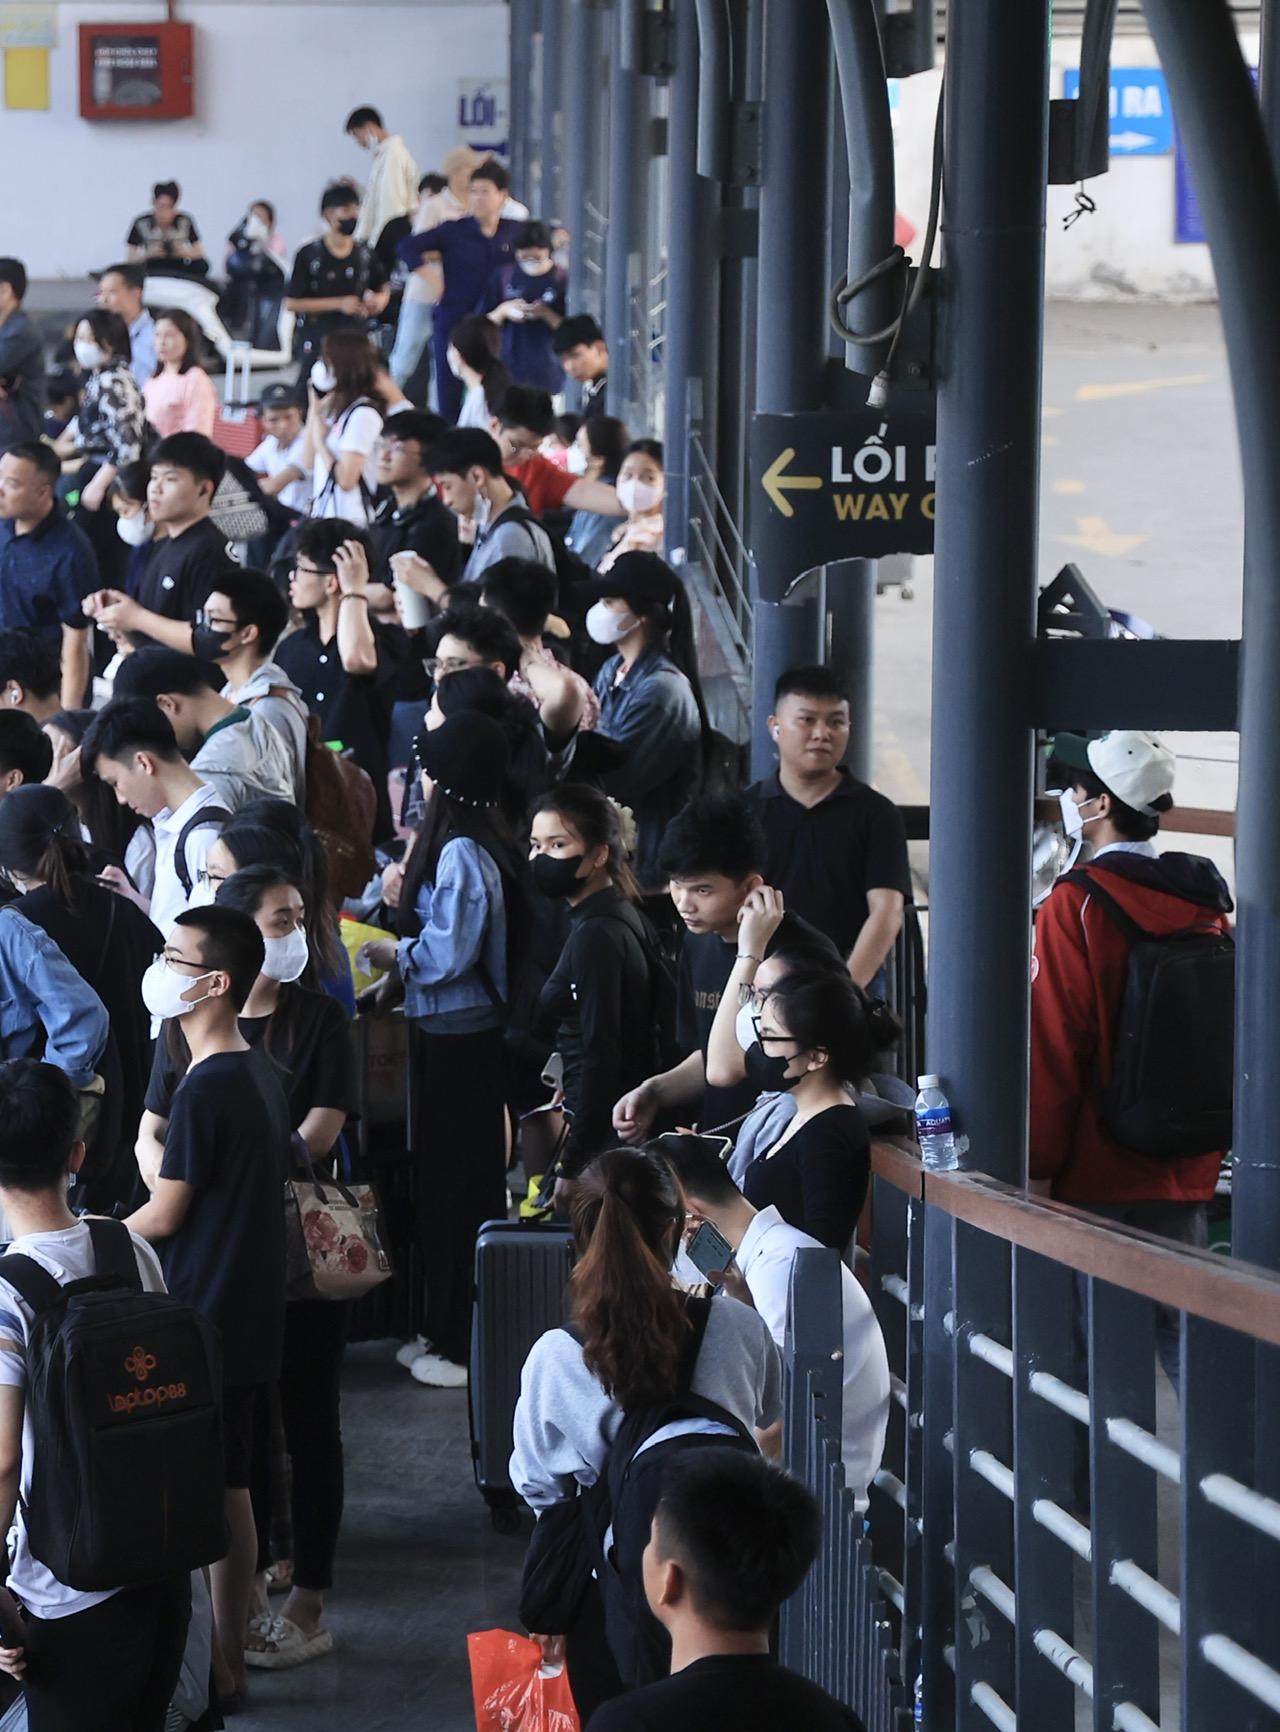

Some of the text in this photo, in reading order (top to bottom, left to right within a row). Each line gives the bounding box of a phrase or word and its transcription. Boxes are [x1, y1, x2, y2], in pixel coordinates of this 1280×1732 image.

[1121, 85, 1163, 118] RA
[831, 422, 907, 483] LỐI
[832, 493, 910, 520] WAY
